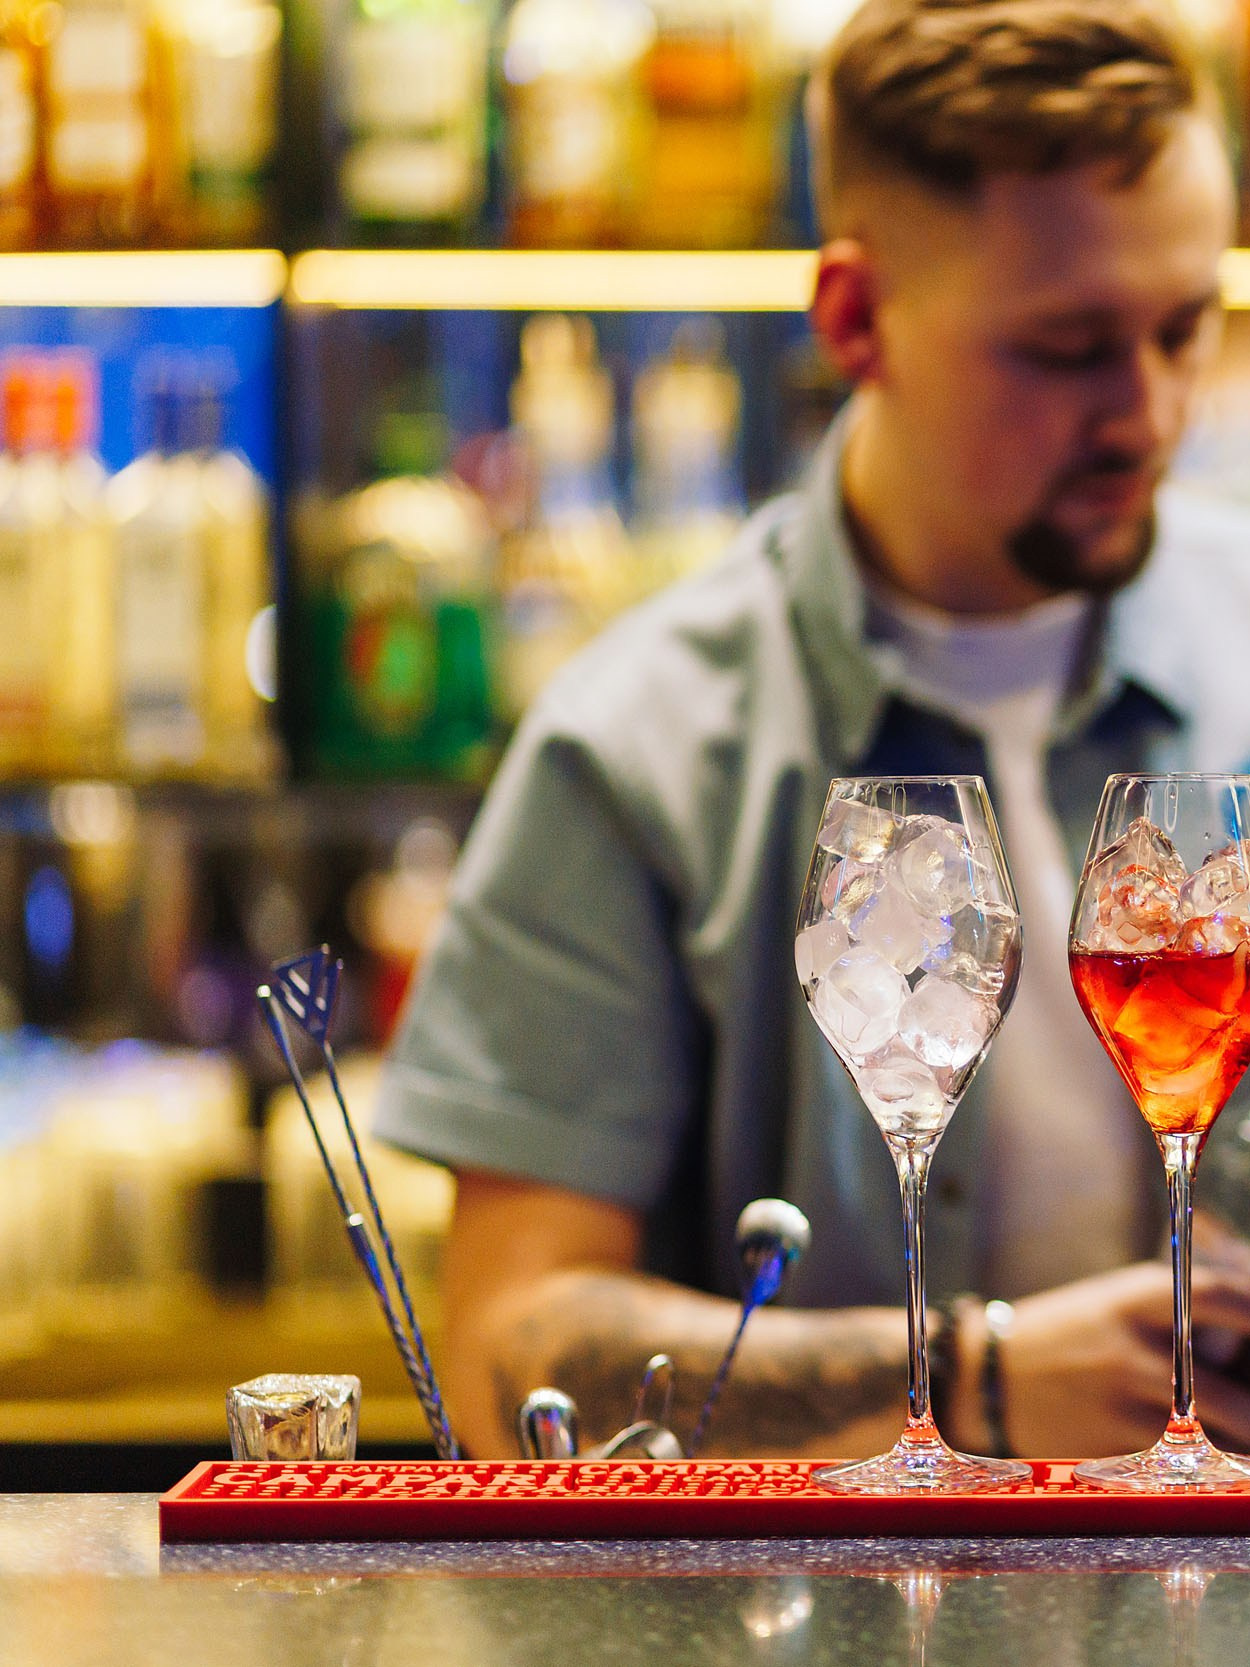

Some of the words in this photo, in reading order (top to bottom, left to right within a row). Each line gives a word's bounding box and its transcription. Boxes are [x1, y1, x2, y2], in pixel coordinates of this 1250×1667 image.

[335, 1465, 465, 1473] CAMPARI
[579, 1464, 811, 1475] CAMPARI
[213, 1472, 570, 1487] CAMPARI
[377, 1485, 633, 1494] CAMPARI
